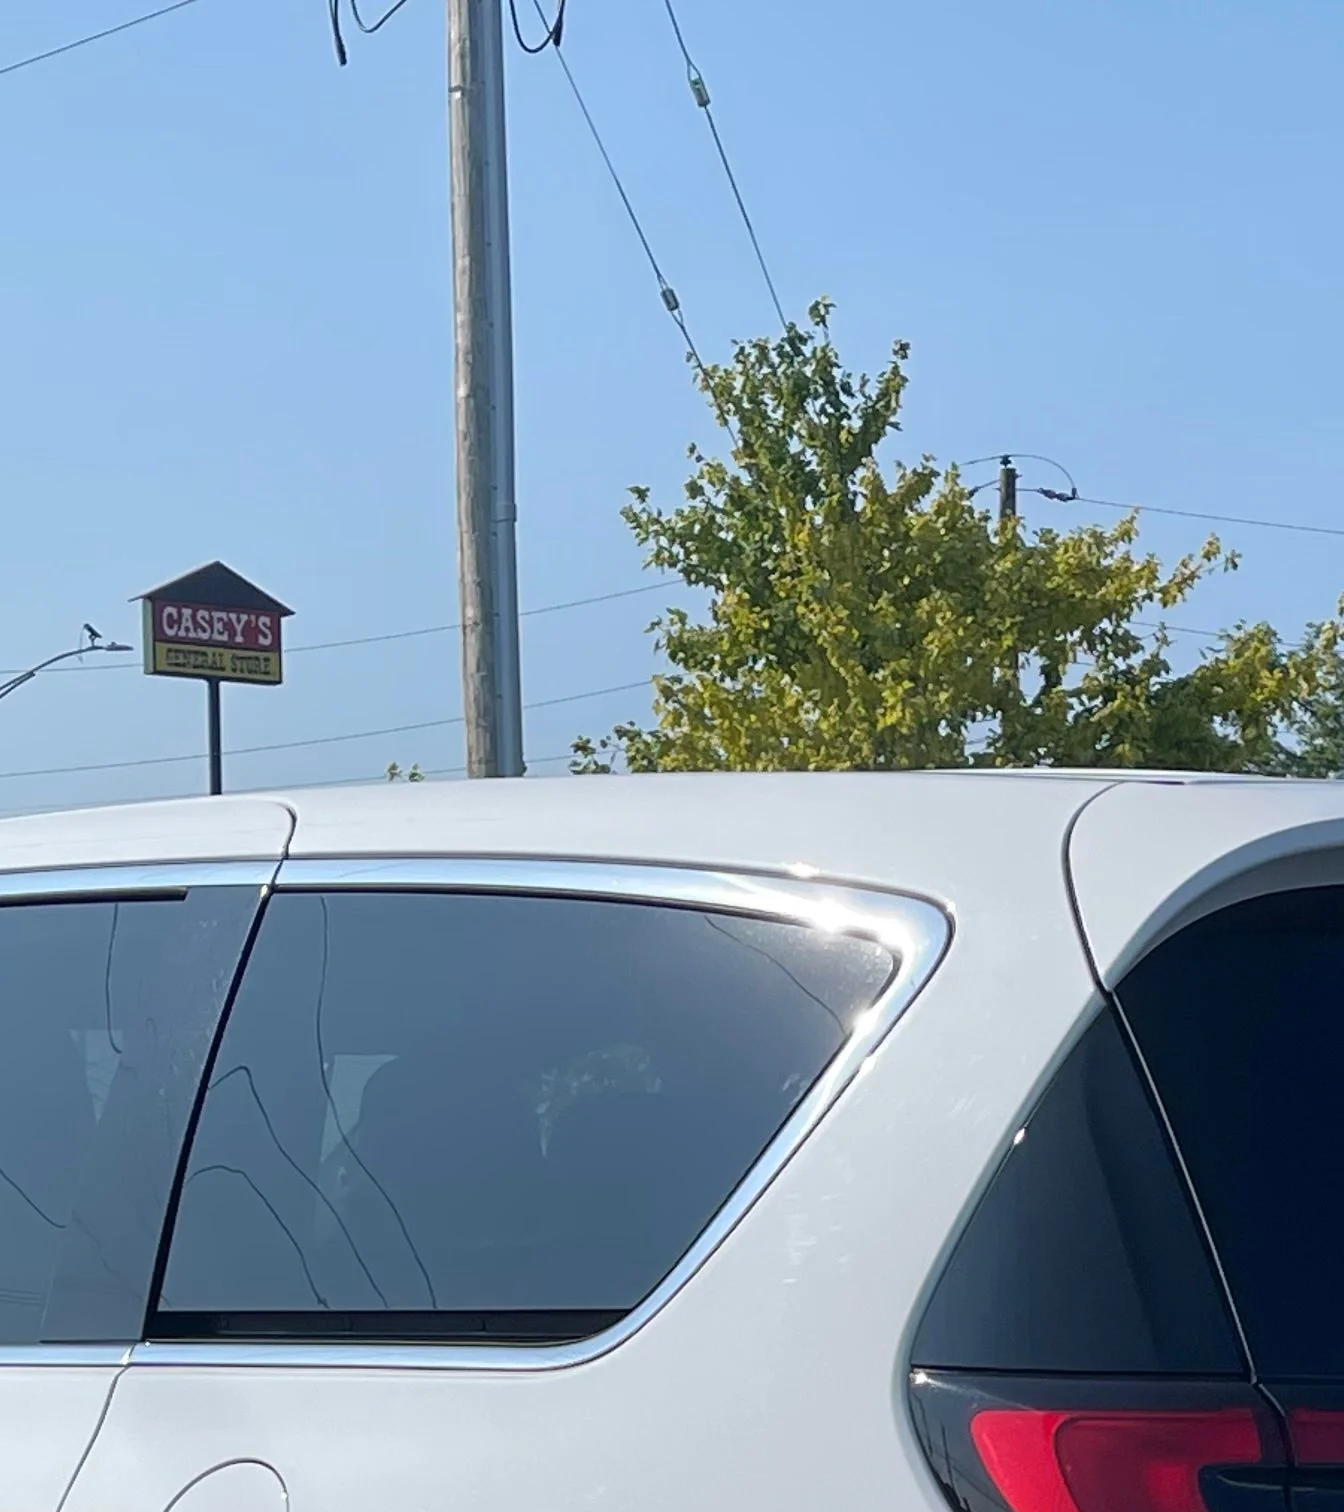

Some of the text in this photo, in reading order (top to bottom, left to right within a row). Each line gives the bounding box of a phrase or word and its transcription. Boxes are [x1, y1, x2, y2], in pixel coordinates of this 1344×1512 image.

[162, 606, 273, 646] CASEY'S
[166, 648, 271, 676] GENERAL STORE
